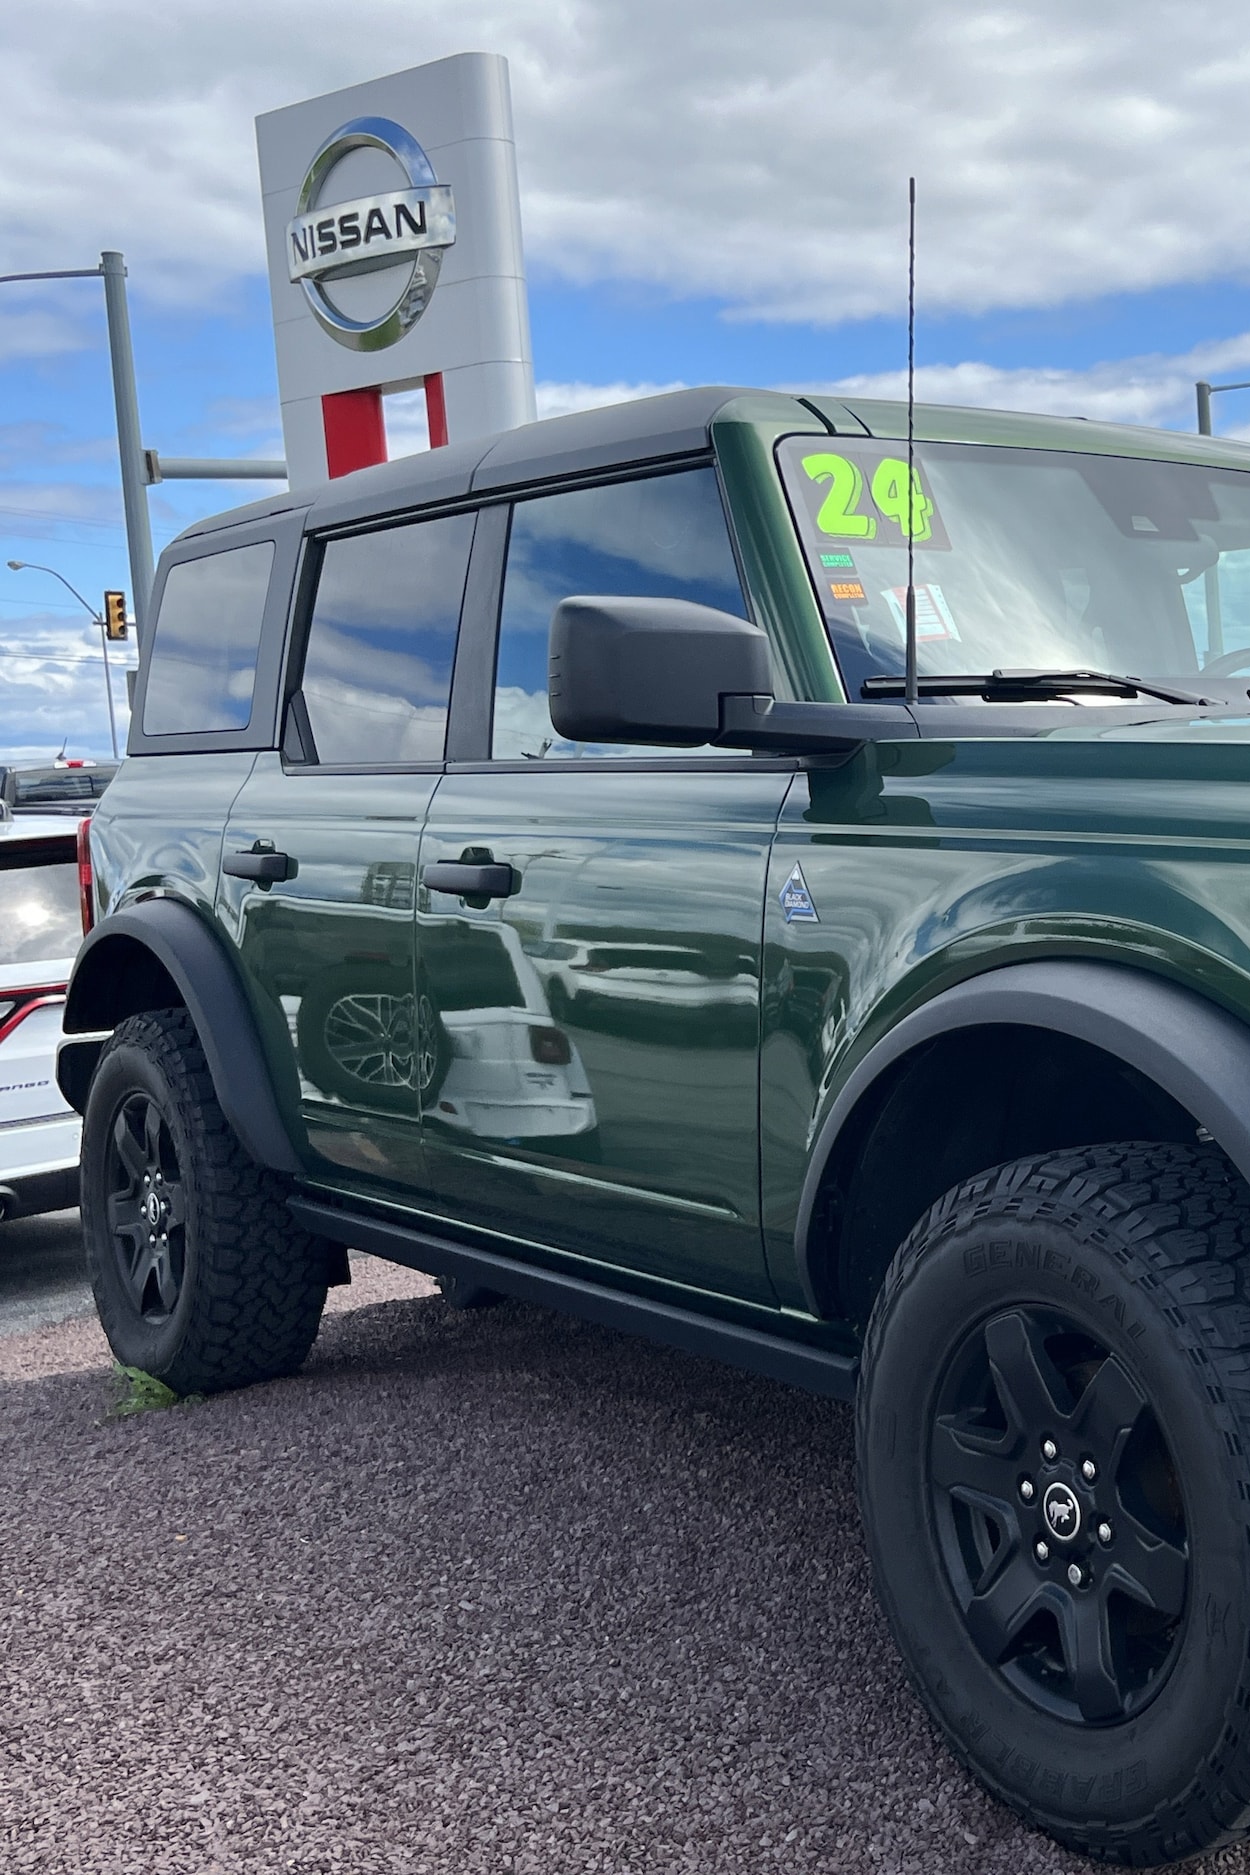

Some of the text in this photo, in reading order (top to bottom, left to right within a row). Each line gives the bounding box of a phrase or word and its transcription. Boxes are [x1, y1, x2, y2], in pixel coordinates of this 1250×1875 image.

[290, 200, 428, 265] NISSAN
[801, 453, 934, 543] 24
[830, 583, 862, 594] RECON
[785, 893, 802, 901] BLACK
[785, 901, 810, 909] DIAMOND
[962, 1239, 1149, 1360] GENERAL
